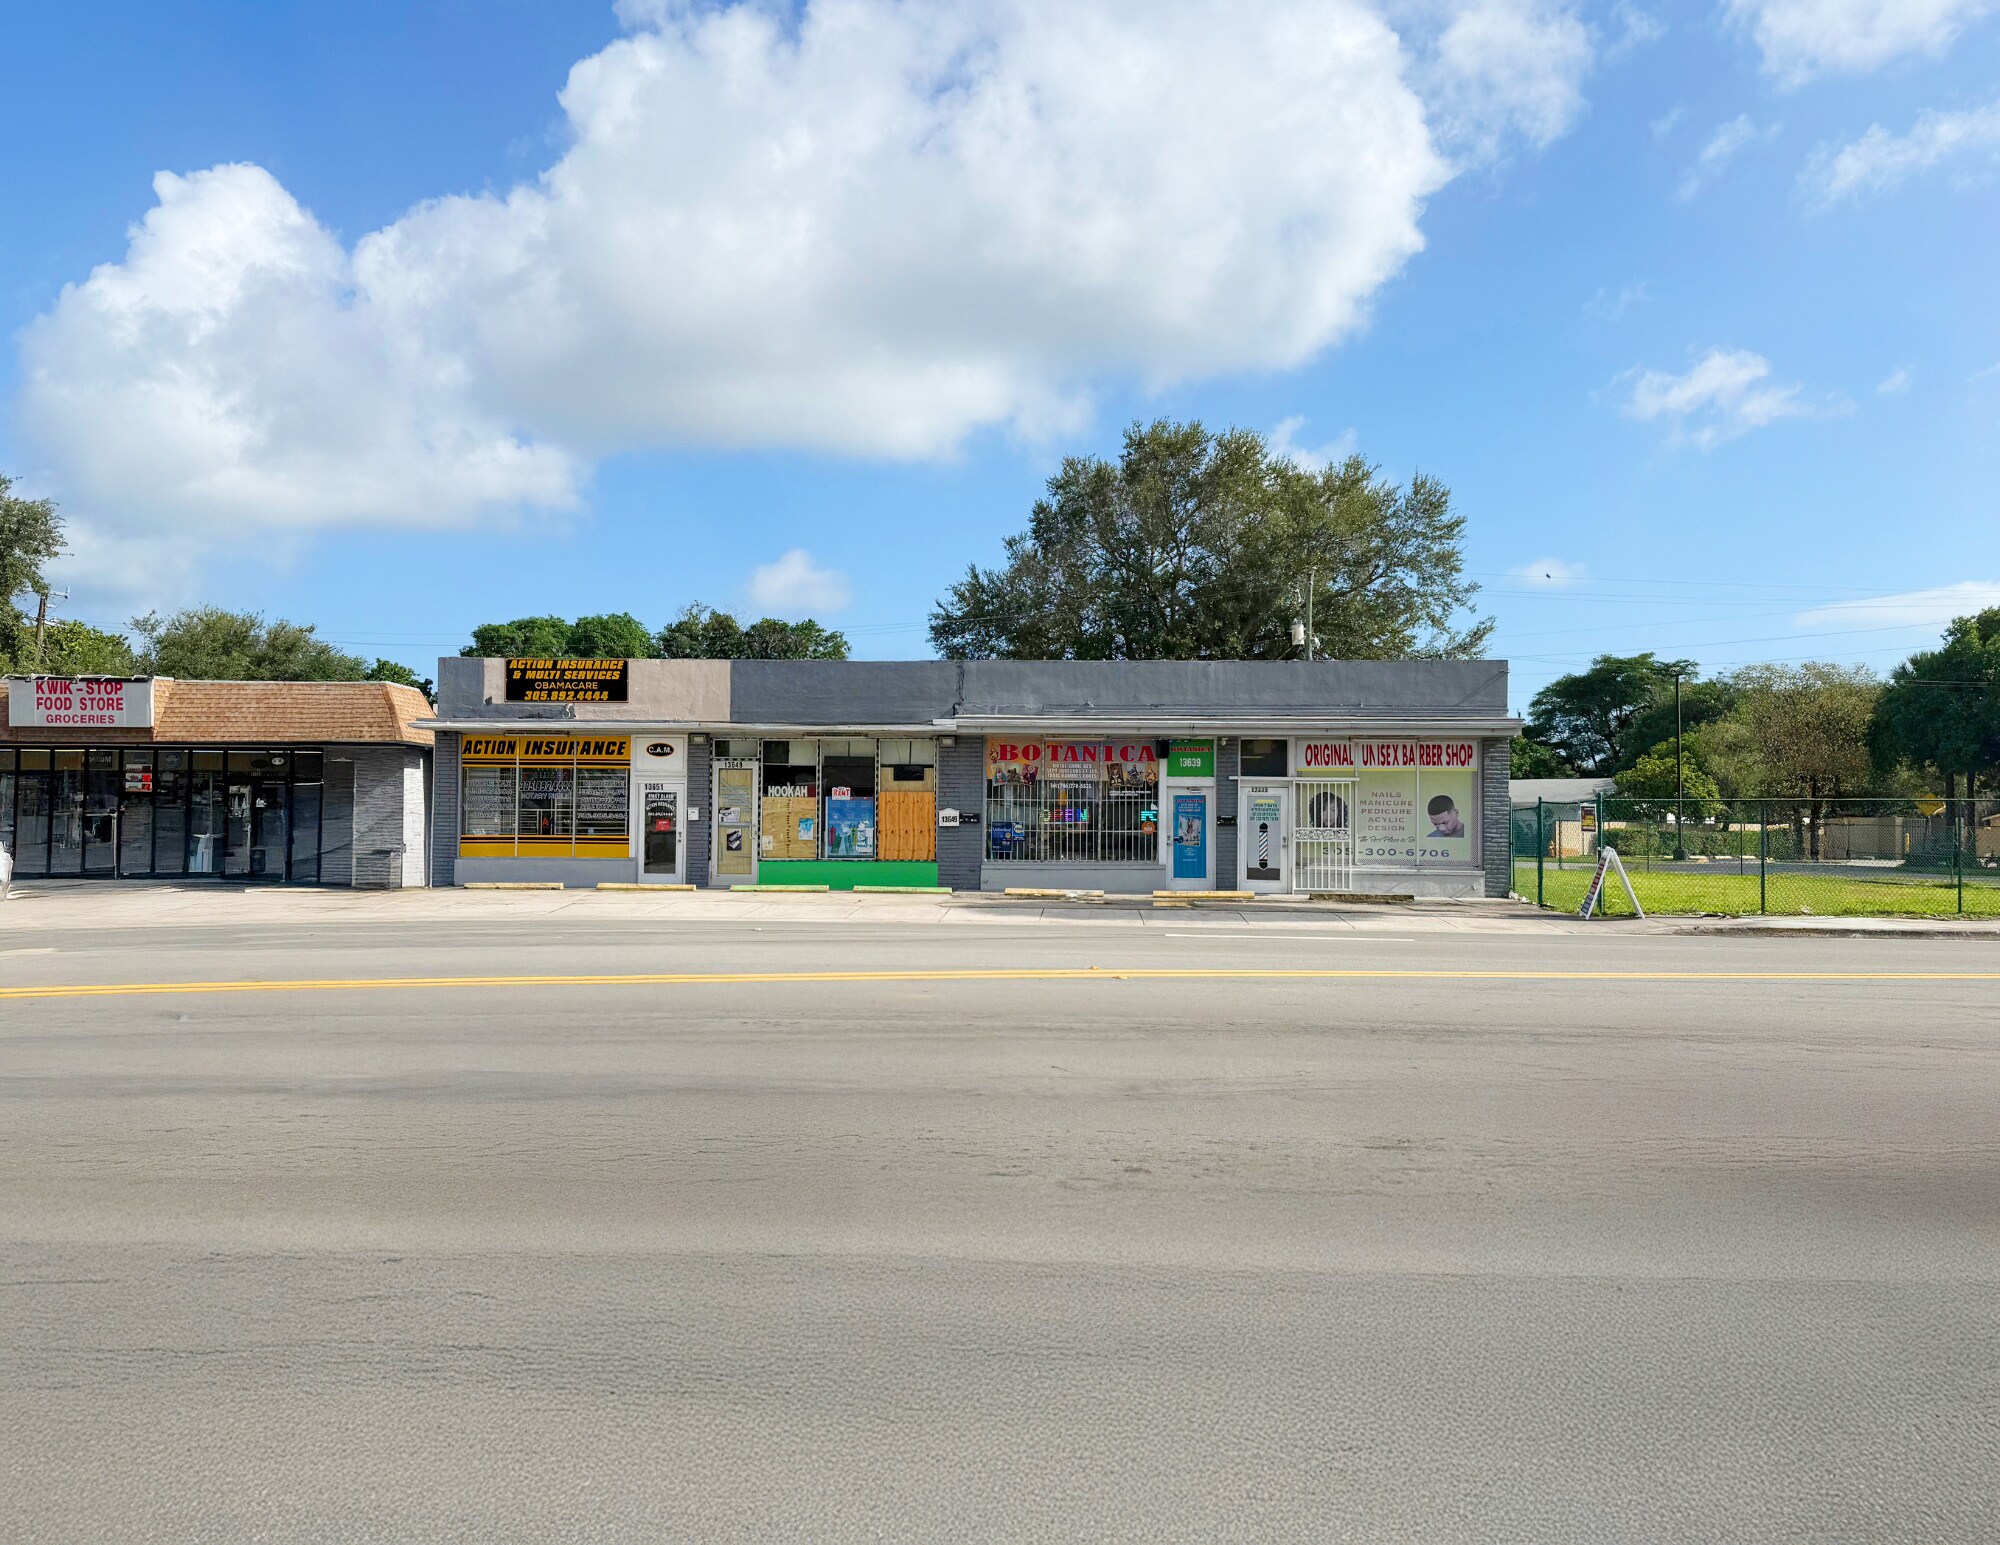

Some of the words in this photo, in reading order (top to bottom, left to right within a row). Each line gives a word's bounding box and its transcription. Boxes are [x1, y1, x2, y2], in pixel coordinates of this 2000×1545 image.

[509, 660, 553, 669] ACTION
[557, 660, 624, 670] INSURANCE
[512, 670, 521, 679] &
[525, 670, 561, 679] MULTI
[563, 670, 620, 680] SERVICES
[534, 681, 598, 690] OBAMACARE
[524, 690, 609, 701] 305.892.4444
[36, 697, 72, 711] FOOD
[80, 697, 124, 711] STORE
[46, 714, 115, 724] GROCERIES
[462, 740, 517, 755] ACTION
[524, 740, 627, 756] INSURANCE
[999, 744, 1156, 762] BOTANICA
[1304, 743, 1353, 767] ORIGINAL
[1402, 743, 1443, 767] BARBER
[1446, 743, 1473, 767] SHOP
[1179, 757, 1201, 767] 13639
[768, 785, 808, 797] HOOKAH
[833, 788, 850, 796] RENT
[1040, 808, 1089, 821] OPEN
